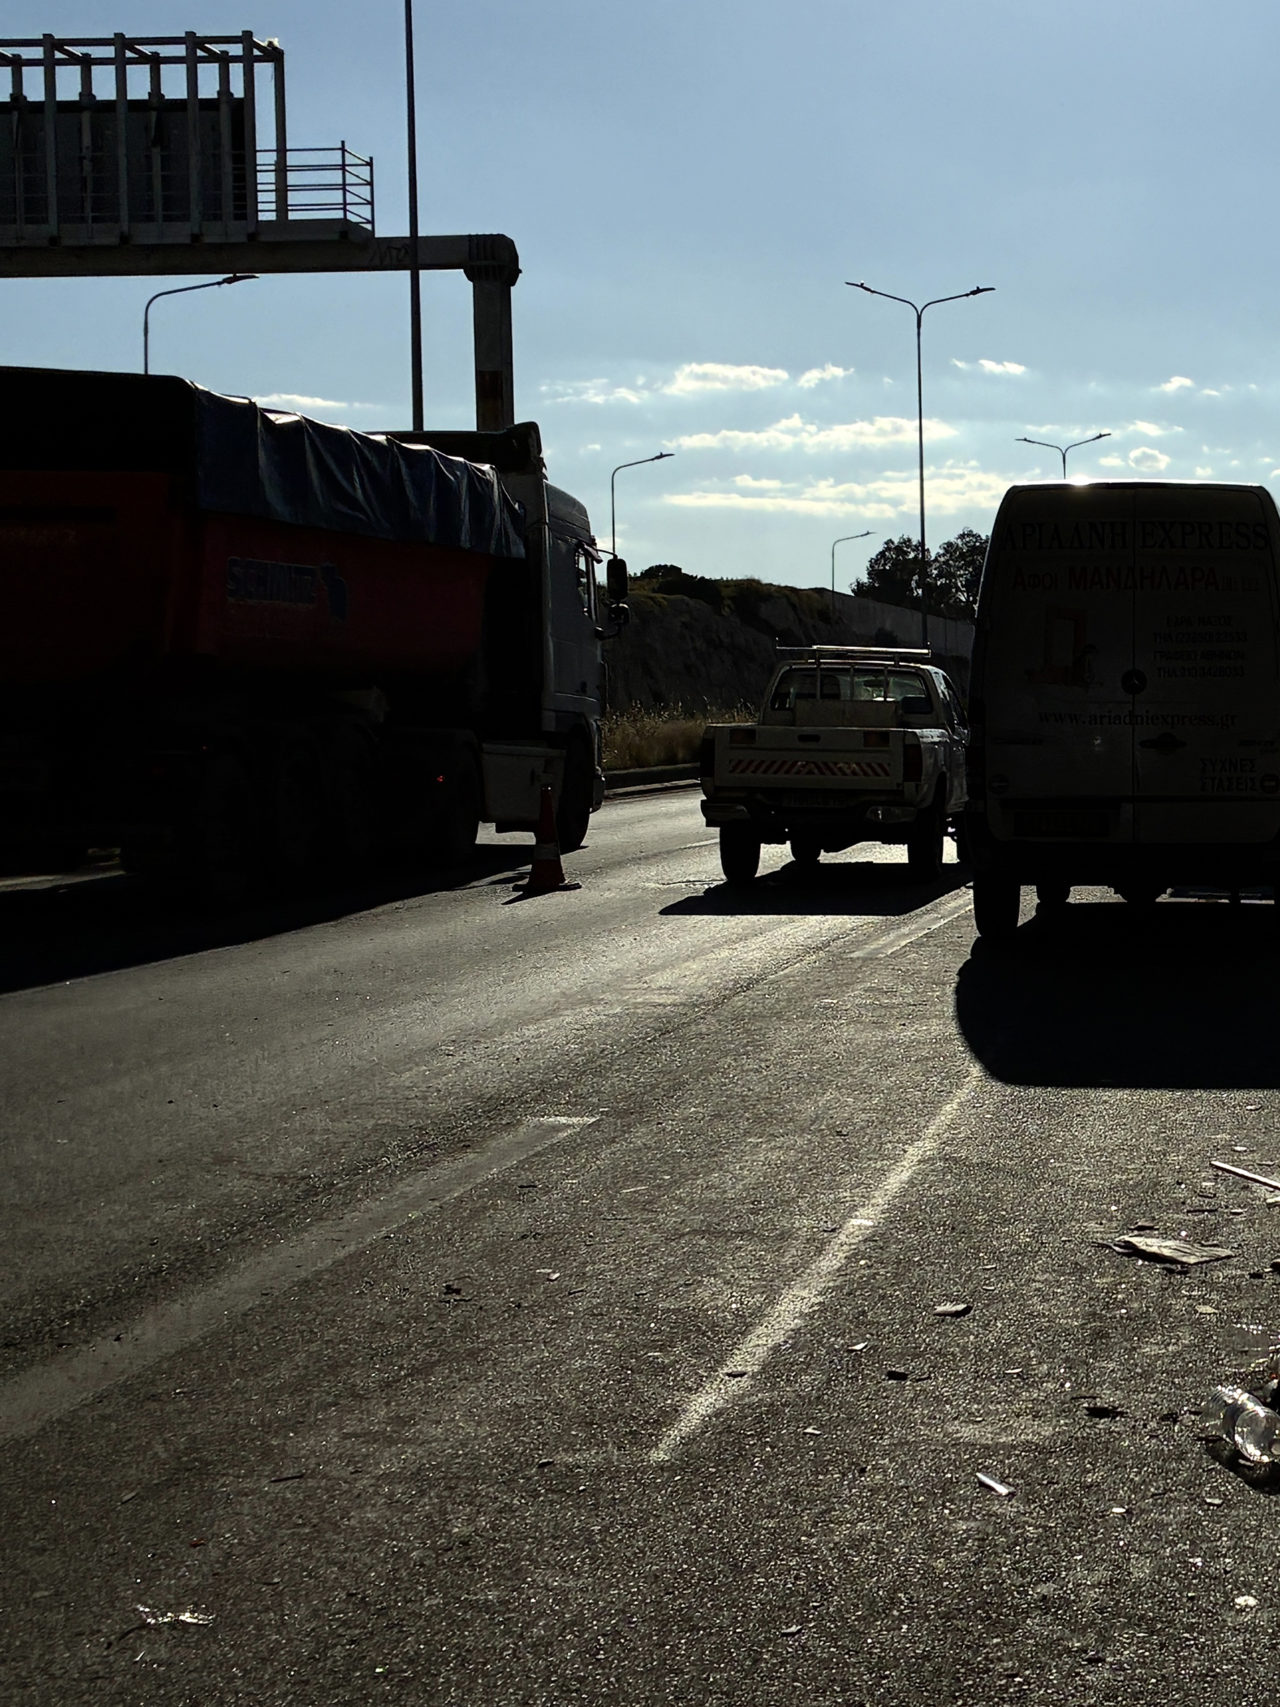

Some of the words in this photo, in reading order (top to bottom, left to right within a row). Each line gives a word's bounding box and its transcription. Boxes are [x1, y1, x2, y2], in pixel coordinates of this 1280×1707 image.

[1001, 521, 1130, 551] ΑΡΙΑΔΝΗ
[1138, 519, 1271, 551] EXPRESS
[1068, 564, 1220, 593] ΜΑΝΔΗΛΑΡΑ
[1038, 709, 1239, 729] www.ariadniexpress.gr
[1200, 757, 1257, 773] ΣΥΧΝΕΣ
[1200, 776, 1258, 792] ΣΤΑΣΕΙΣ
